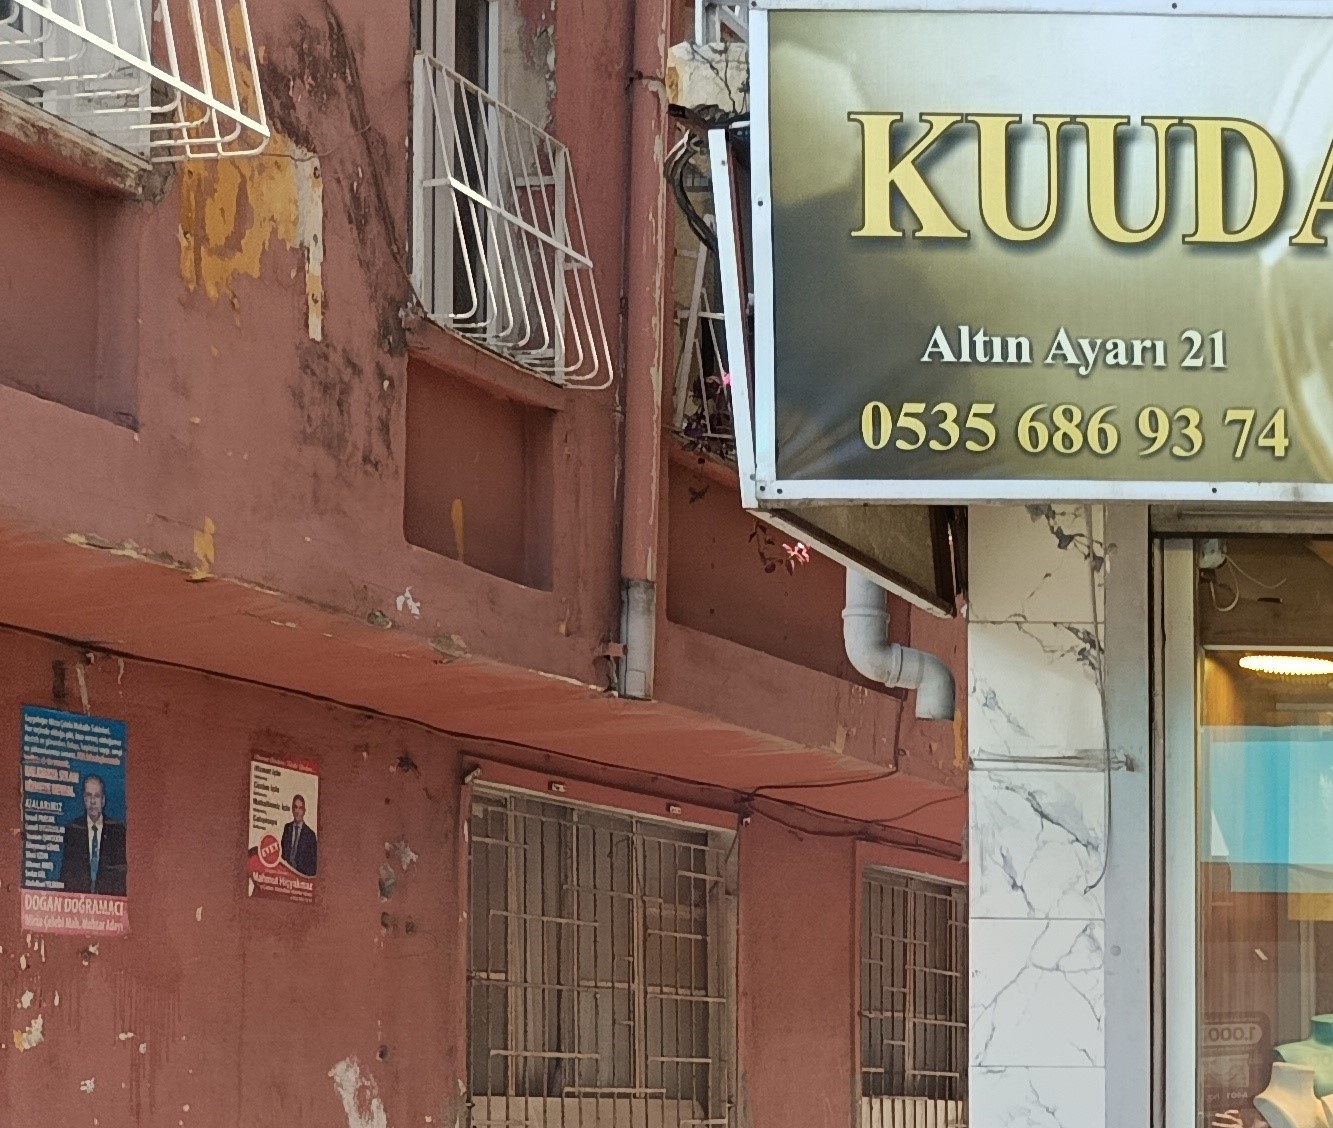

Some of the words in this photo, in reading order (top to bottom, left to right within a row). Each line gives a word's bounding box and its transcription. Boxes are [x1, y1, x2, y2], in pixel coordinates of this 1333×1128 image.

[920, 325, 1032, 364] Altın
[1044, 327, 1167, 375] Ayarı
[1180, 330, 1228, 369] 21
[861, 401, 997, 451] 0535
[1017, 404, 1119, 454] 686
[1138, 406, 1203, 457] 93
[1223, 408, 1289, 459] 74
[24, 891, 62, 912] DOĞAN
